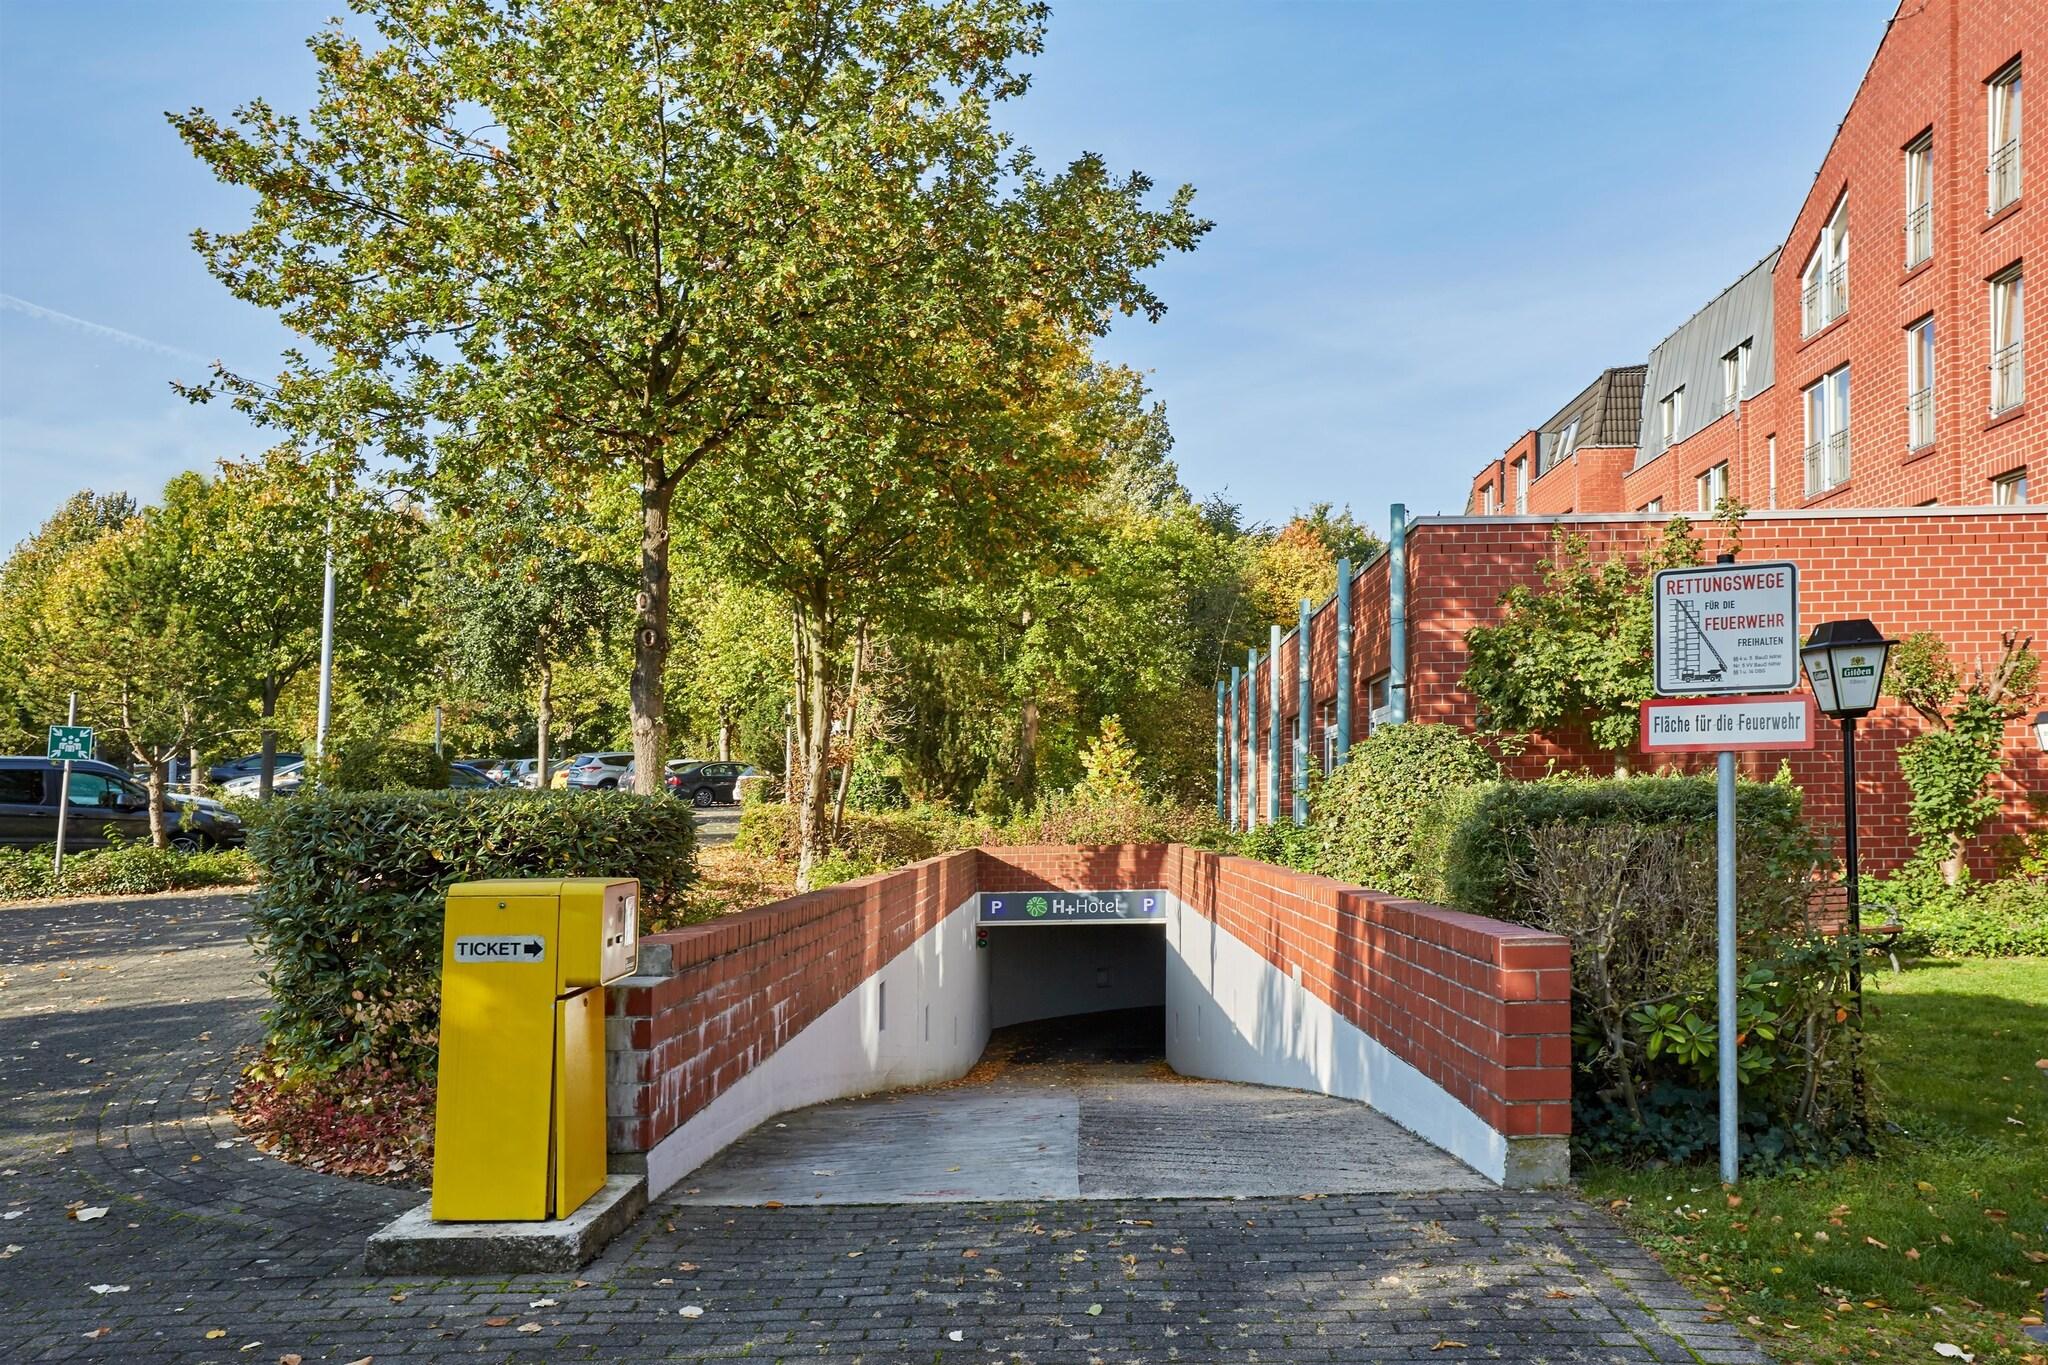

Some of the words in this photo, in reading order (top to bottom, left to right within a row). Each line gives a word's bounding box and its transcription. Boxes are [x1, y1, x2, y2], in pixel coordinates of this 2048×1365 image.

[1666, 573, 1785, 595] RETTUNGSWEGE
[1704, 601, 1720, 610] FÜR
[1723, 600, 1735, 609] DIE
[1705, 613, 1785, 631] FEUERWEHR
[1737, 636, 1784, 647] FREIHALTEN
[1844, 668, 1872, 677] Gilden
[1653, 715, 1690, 733] Fläche
[1695, 714, 1712, 732] für
[1716, 714, 1733, 731] die
[1738, 712, 1801, 731] Feuerwehr
[991, 900, 1003, 914] P
[1052, 897, 1120, 915] H+Hotel
[1143, 898, 1154, 912] P
[457, 942, 521, 956] TICKET
